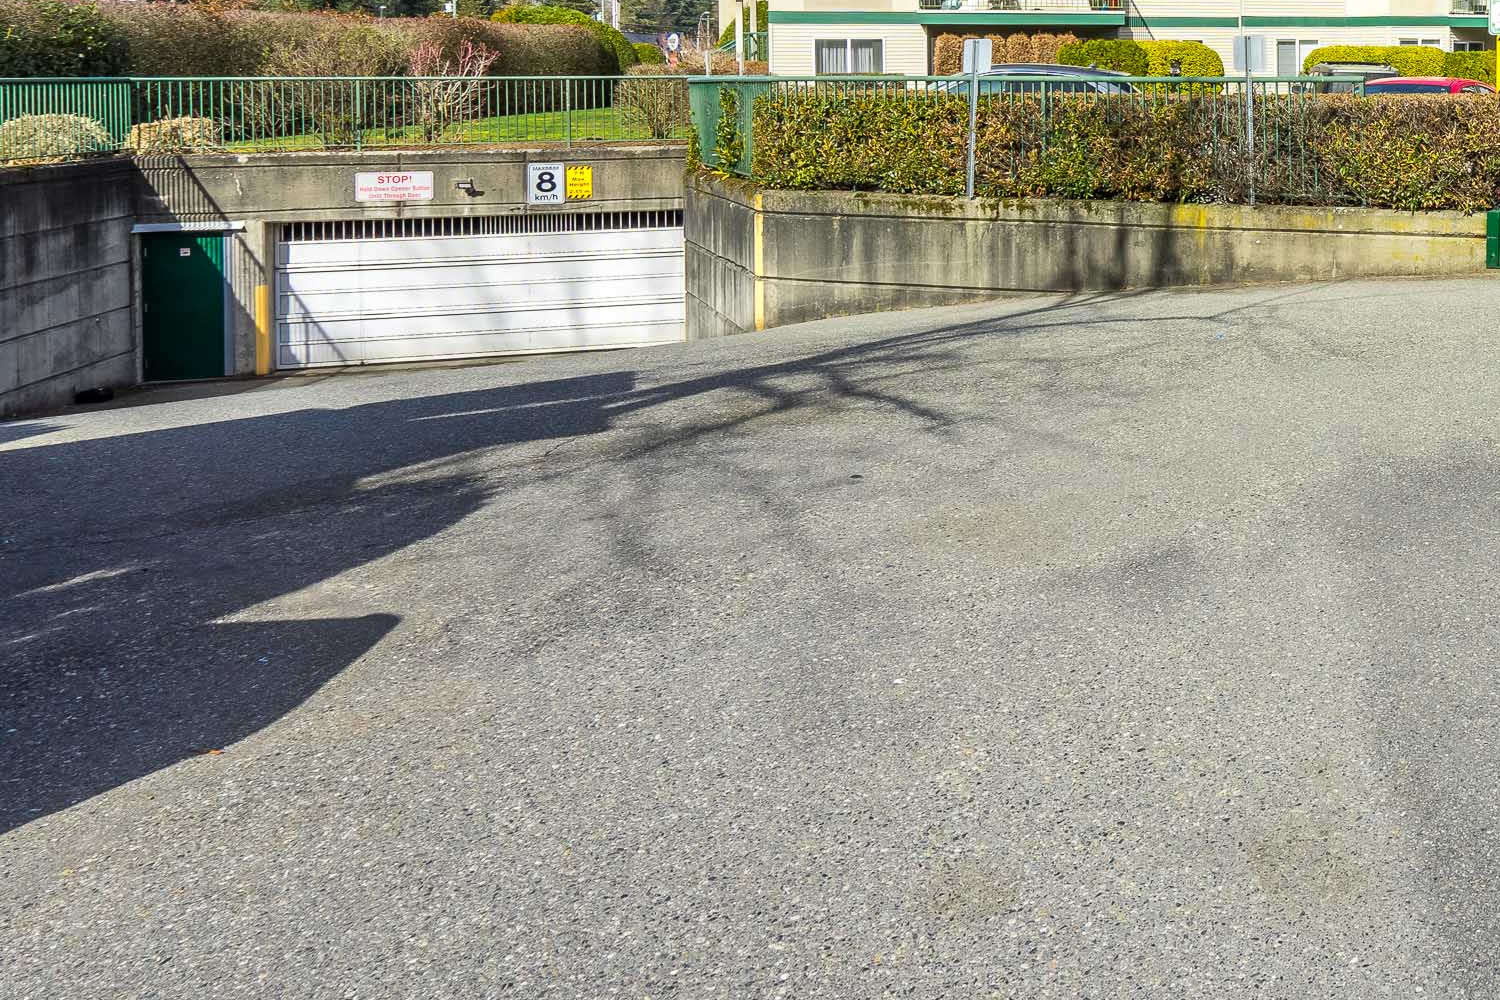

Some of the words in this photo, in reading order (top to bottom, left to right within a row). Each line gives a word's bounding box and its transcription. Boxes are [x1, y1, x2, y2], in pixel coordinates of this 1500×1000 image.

[377, 175, 412, 184] STOP!
[536, 171, 557, 193] 8
[535, 193, 558, 201] km/h
